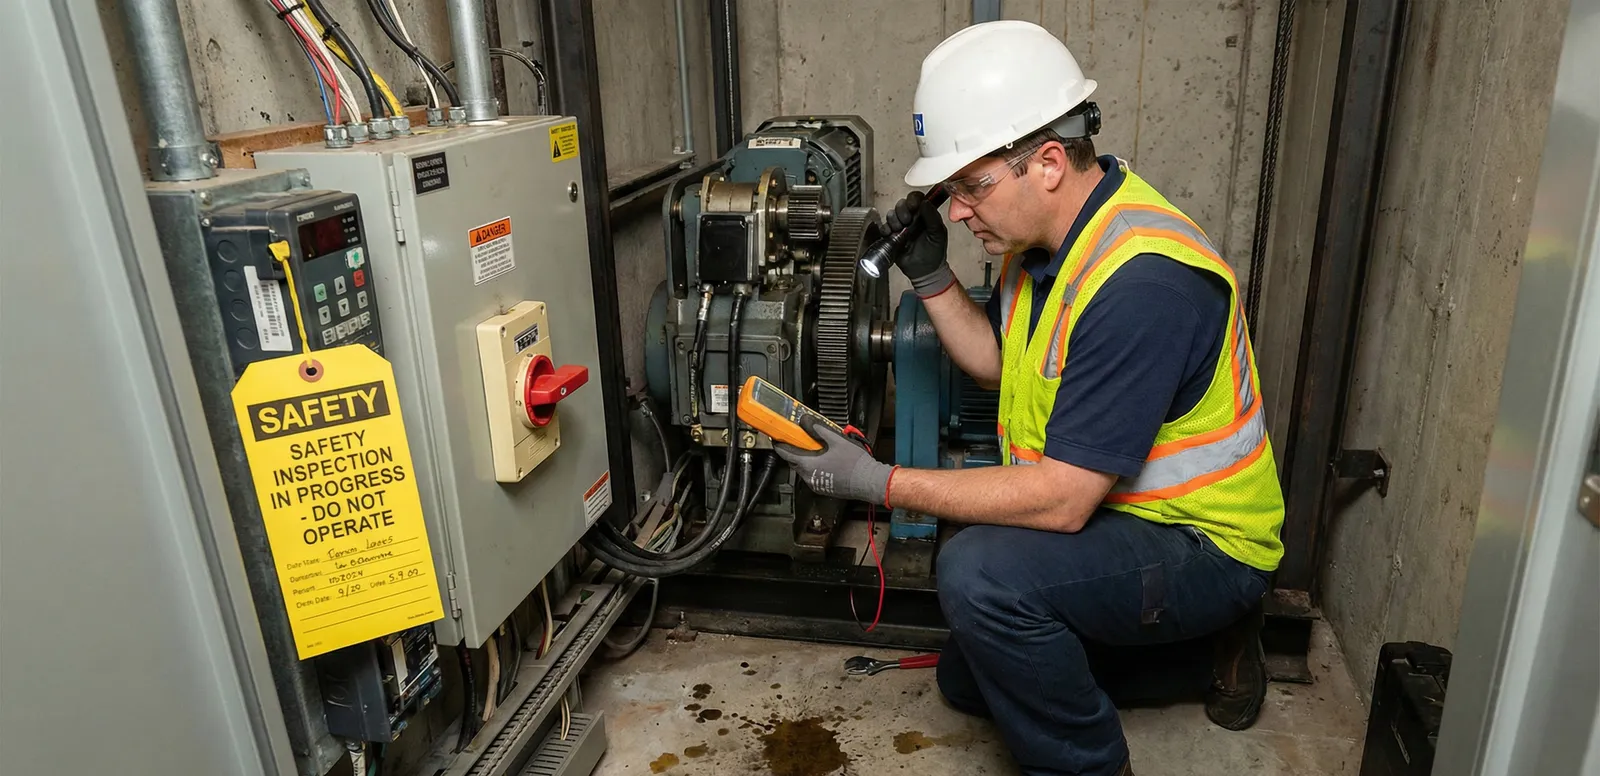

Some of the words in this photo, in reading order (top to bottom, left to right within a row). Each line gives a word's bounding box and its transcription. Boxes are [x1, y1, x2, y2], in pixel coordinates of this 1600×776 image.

[482, 223, 506, 240] DANGER
[258, 387, 378, 434] SAFETY
[290, 429, 366, 460] SAFETY
[273, 446, 393, 486] INSPECTION
[270, 490, 292, 509] IN
[297, 465, 406, 503] PROGRESS
[312, 501, 341, 522] DO
[347, 490, 386, 513] NOT
[303, 509, 395, 545] OPERATE
